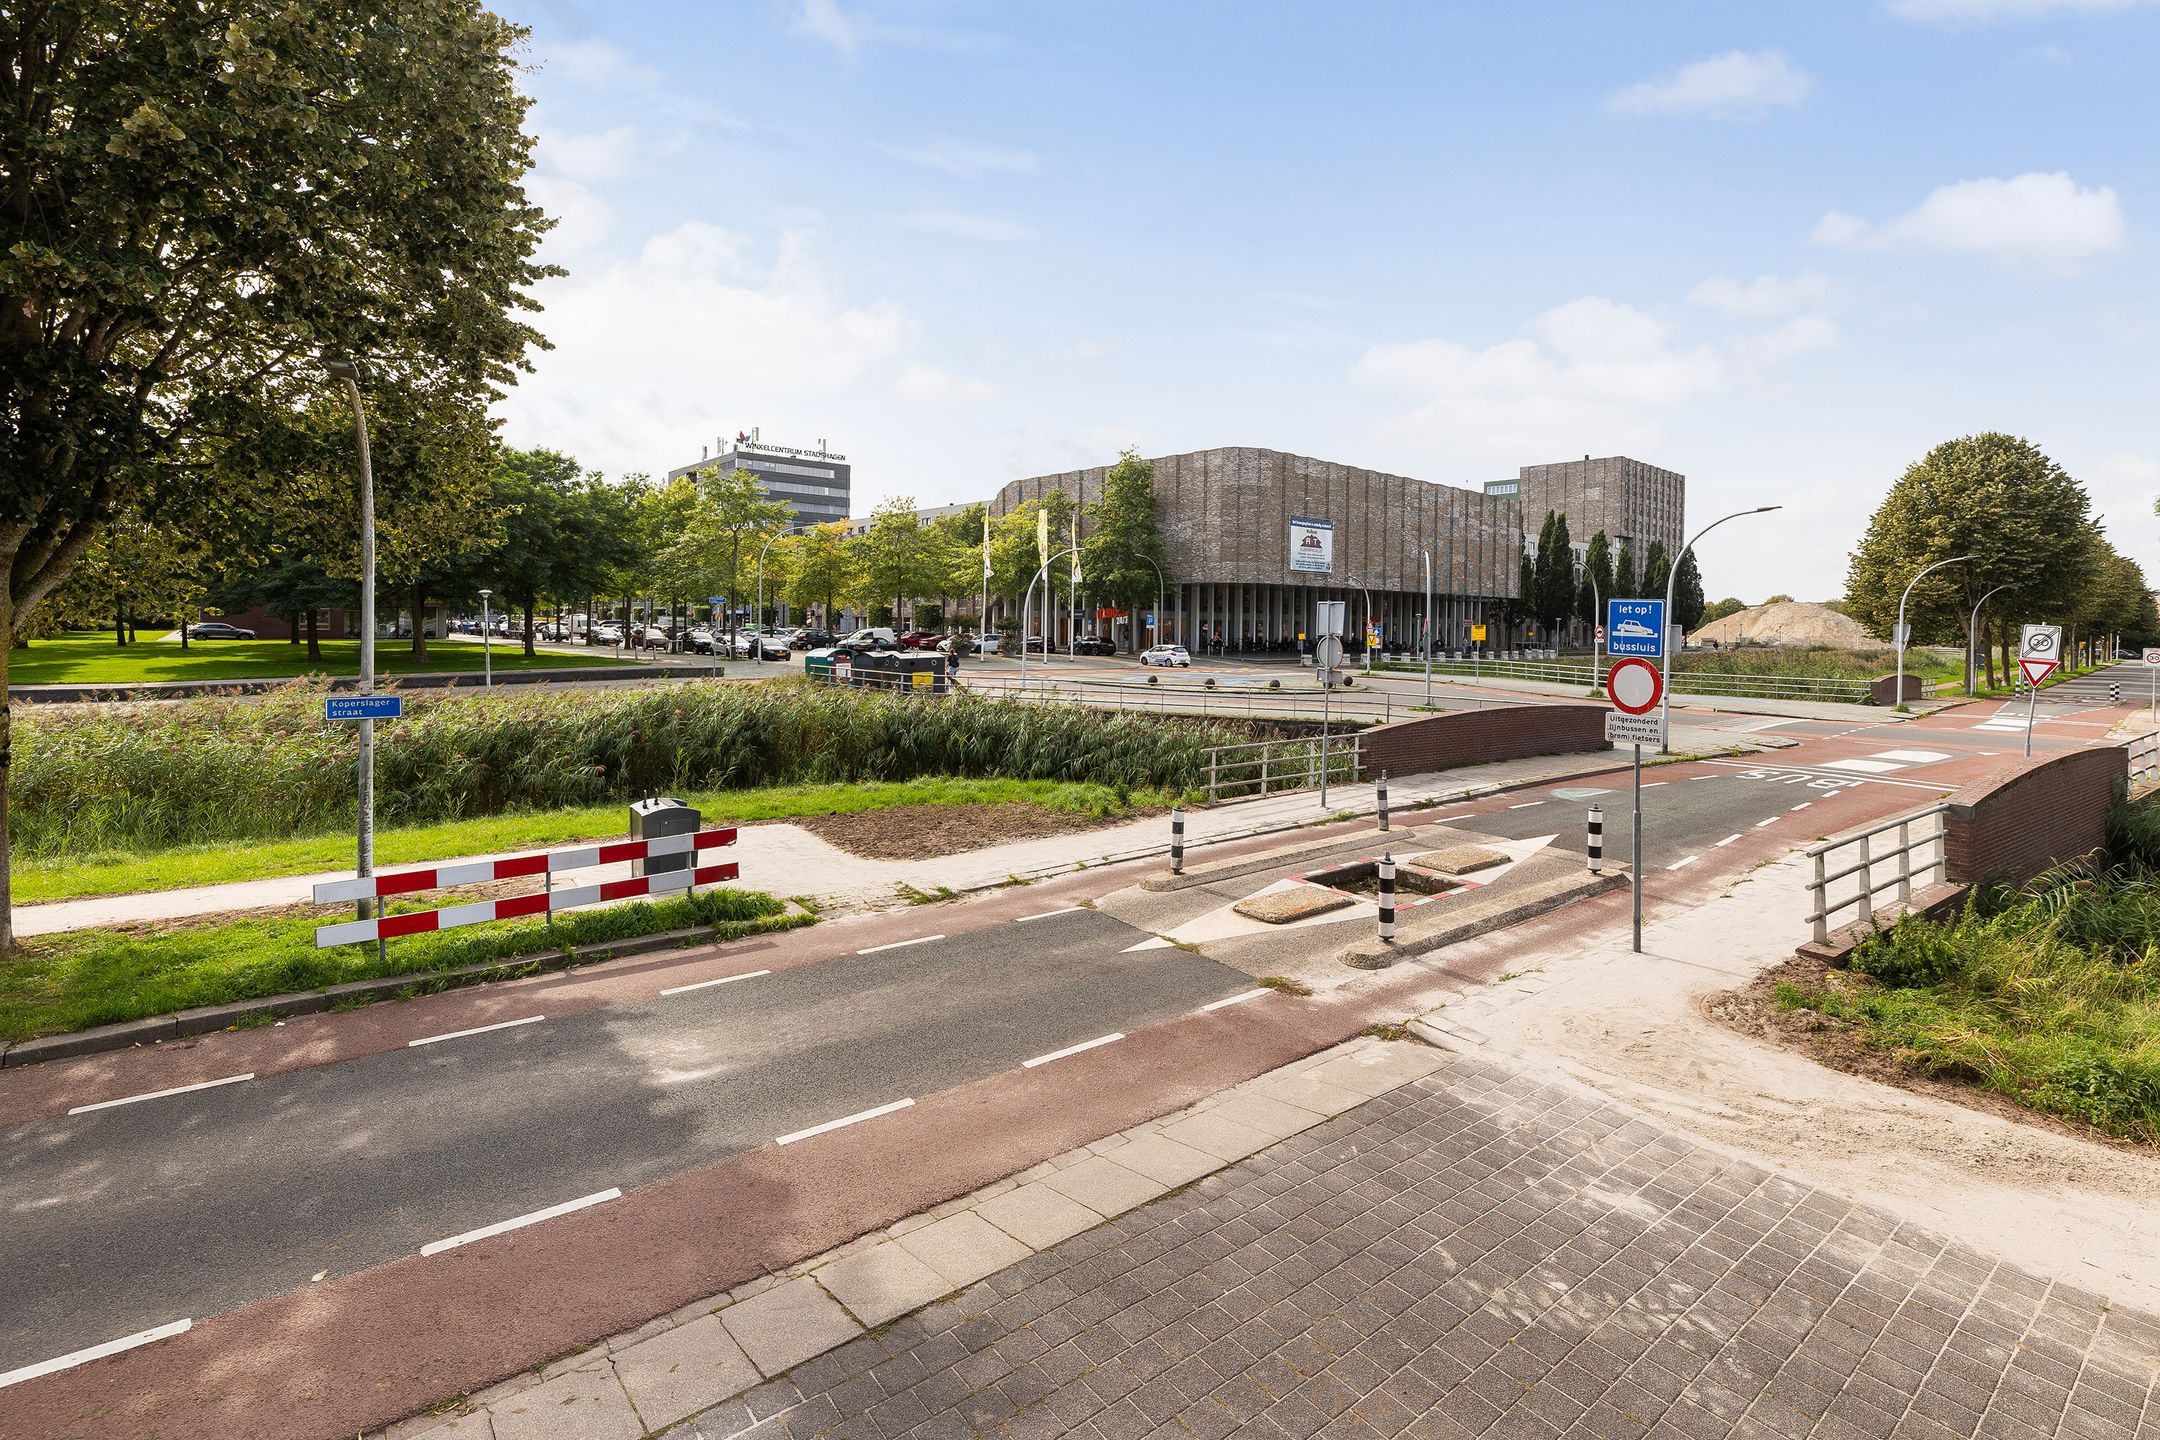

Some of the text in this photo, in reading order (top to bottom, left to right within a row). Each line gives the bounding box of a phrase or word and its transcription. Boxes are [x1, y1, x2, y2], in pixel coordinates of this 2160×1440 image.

[745, 442, 846, 461] WINKELCENTRUM STADSHAGEN
[1619, 604, 1633, 614] let
[1613, 641, 1656, 652] bussluis
[2032, 638, 2050, 647] 30
[1610, 715, 1658, 726] Uitgezonderd
[1609, 724, 1647, 733] lijnbussen
[1632, 734, 1661, 743] fietsers
[1736, 769, 1852, 789] BUS
